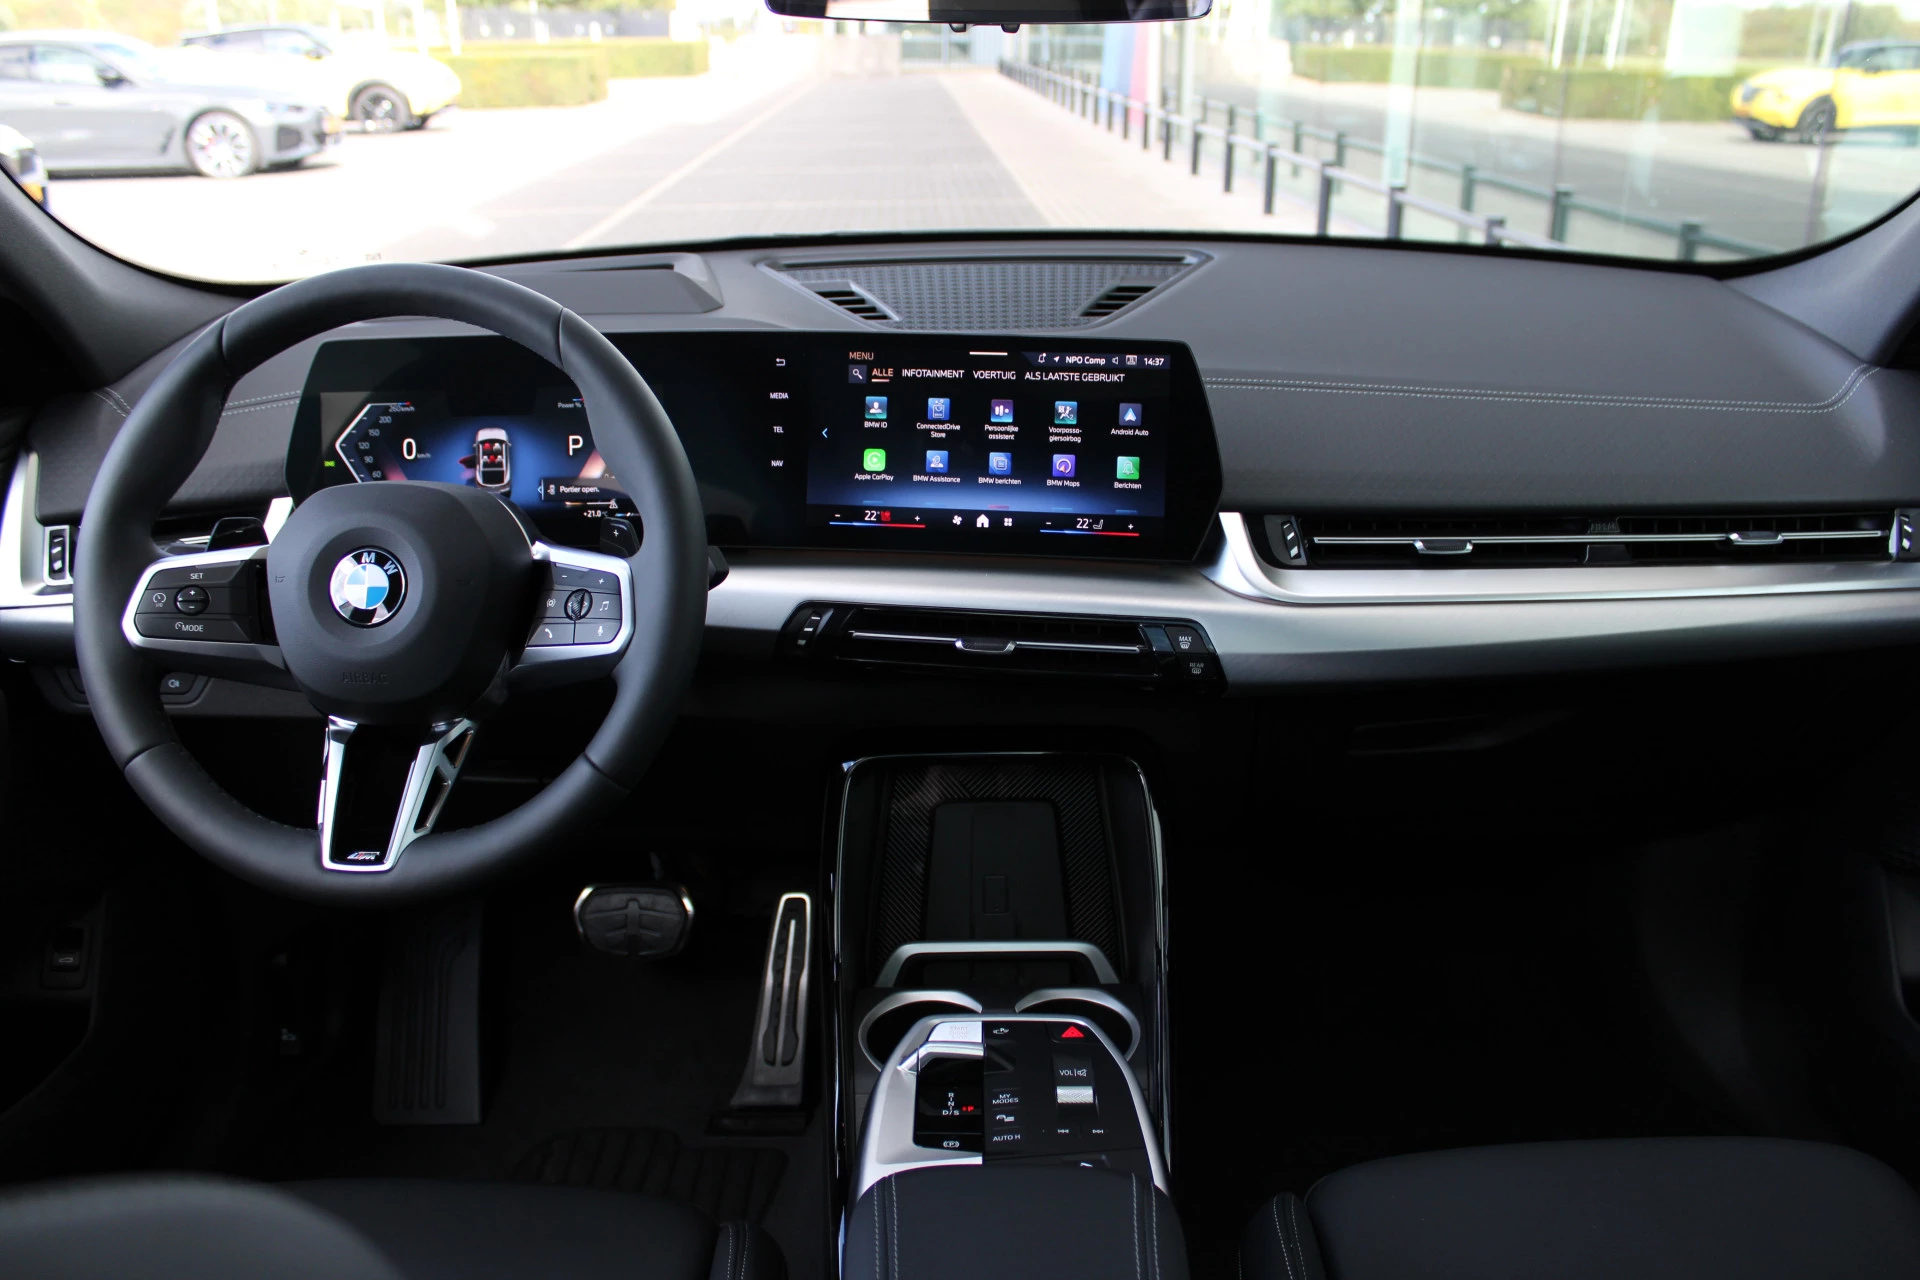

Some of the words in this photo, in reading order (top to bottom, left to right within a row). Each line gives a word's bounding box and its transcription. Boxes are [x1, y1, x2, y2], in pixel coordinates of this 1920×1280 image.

[849, 352, 874, 360] MENU
[1144, 358, 1165, 366] 14:37
[872, 368, 894, 377] ALLE
[902, 369, 965, 378] INFOTAINMENT
[973, 370, 1017, 380] VOERTUIG
[1024, 372, 1041, 380] ALS
[1042, 372, 1080, 382] LAATSTE
[1082, 373, 1125, 382] GEBRUIKT
[916, 422, 960, 430] ConnectedDrive
[1049, 435, 1082, 443] giersairbag
[402, 438, 416, 460] 0
[568, 435, 583, 456] P
[872, 474, 894, 482] CarPlay
[582, 486, 600, 494] open.
